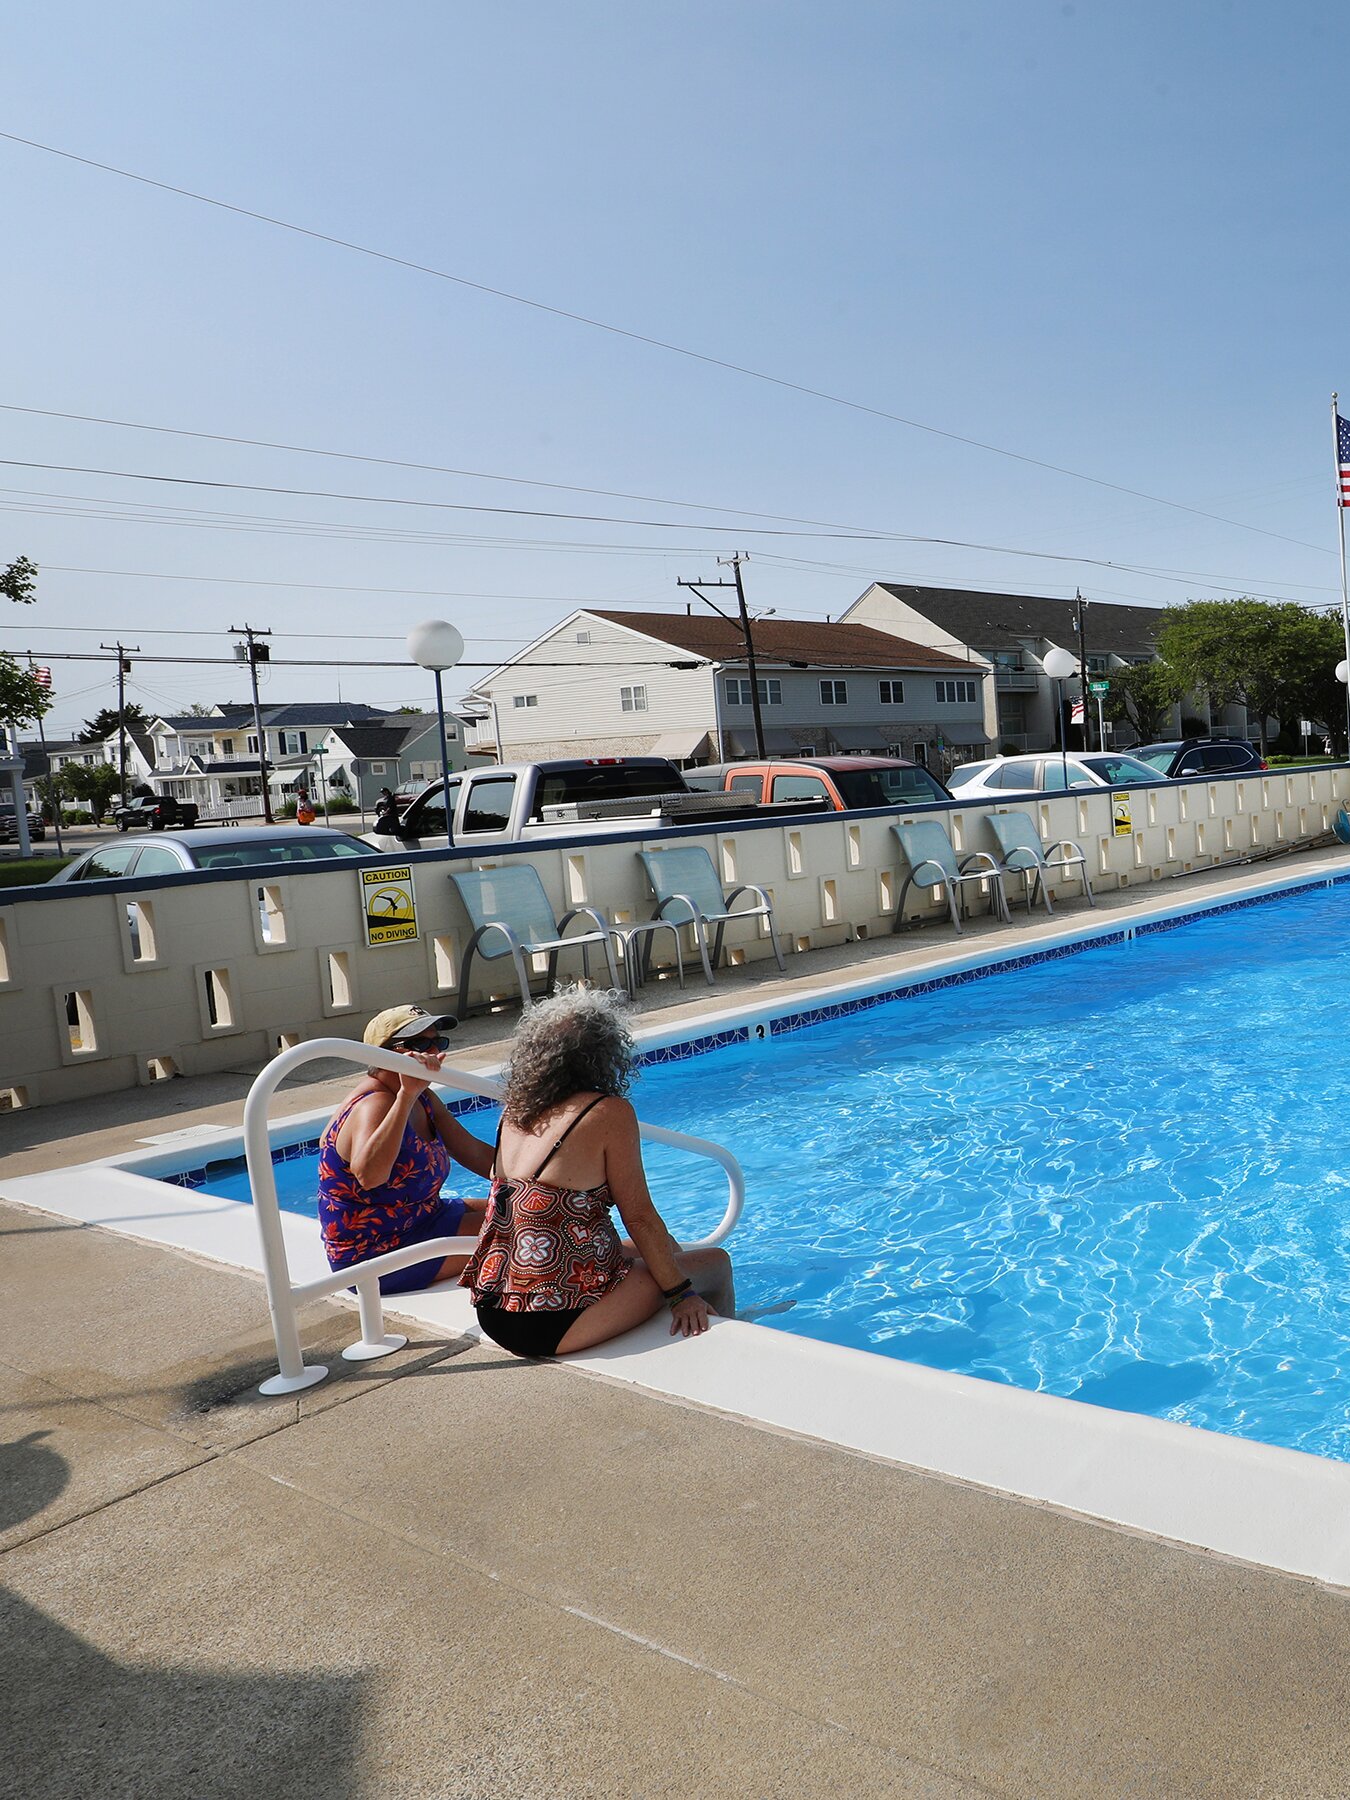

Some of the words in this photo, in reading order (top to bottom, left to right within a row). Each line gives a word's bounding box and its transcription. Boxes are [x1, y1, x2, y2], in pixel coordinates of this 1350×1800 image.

[365, 870, 408, 882] CAUTION
[371, 932, 384, 941] NO
[386, 927, 415, 939] DIVING
